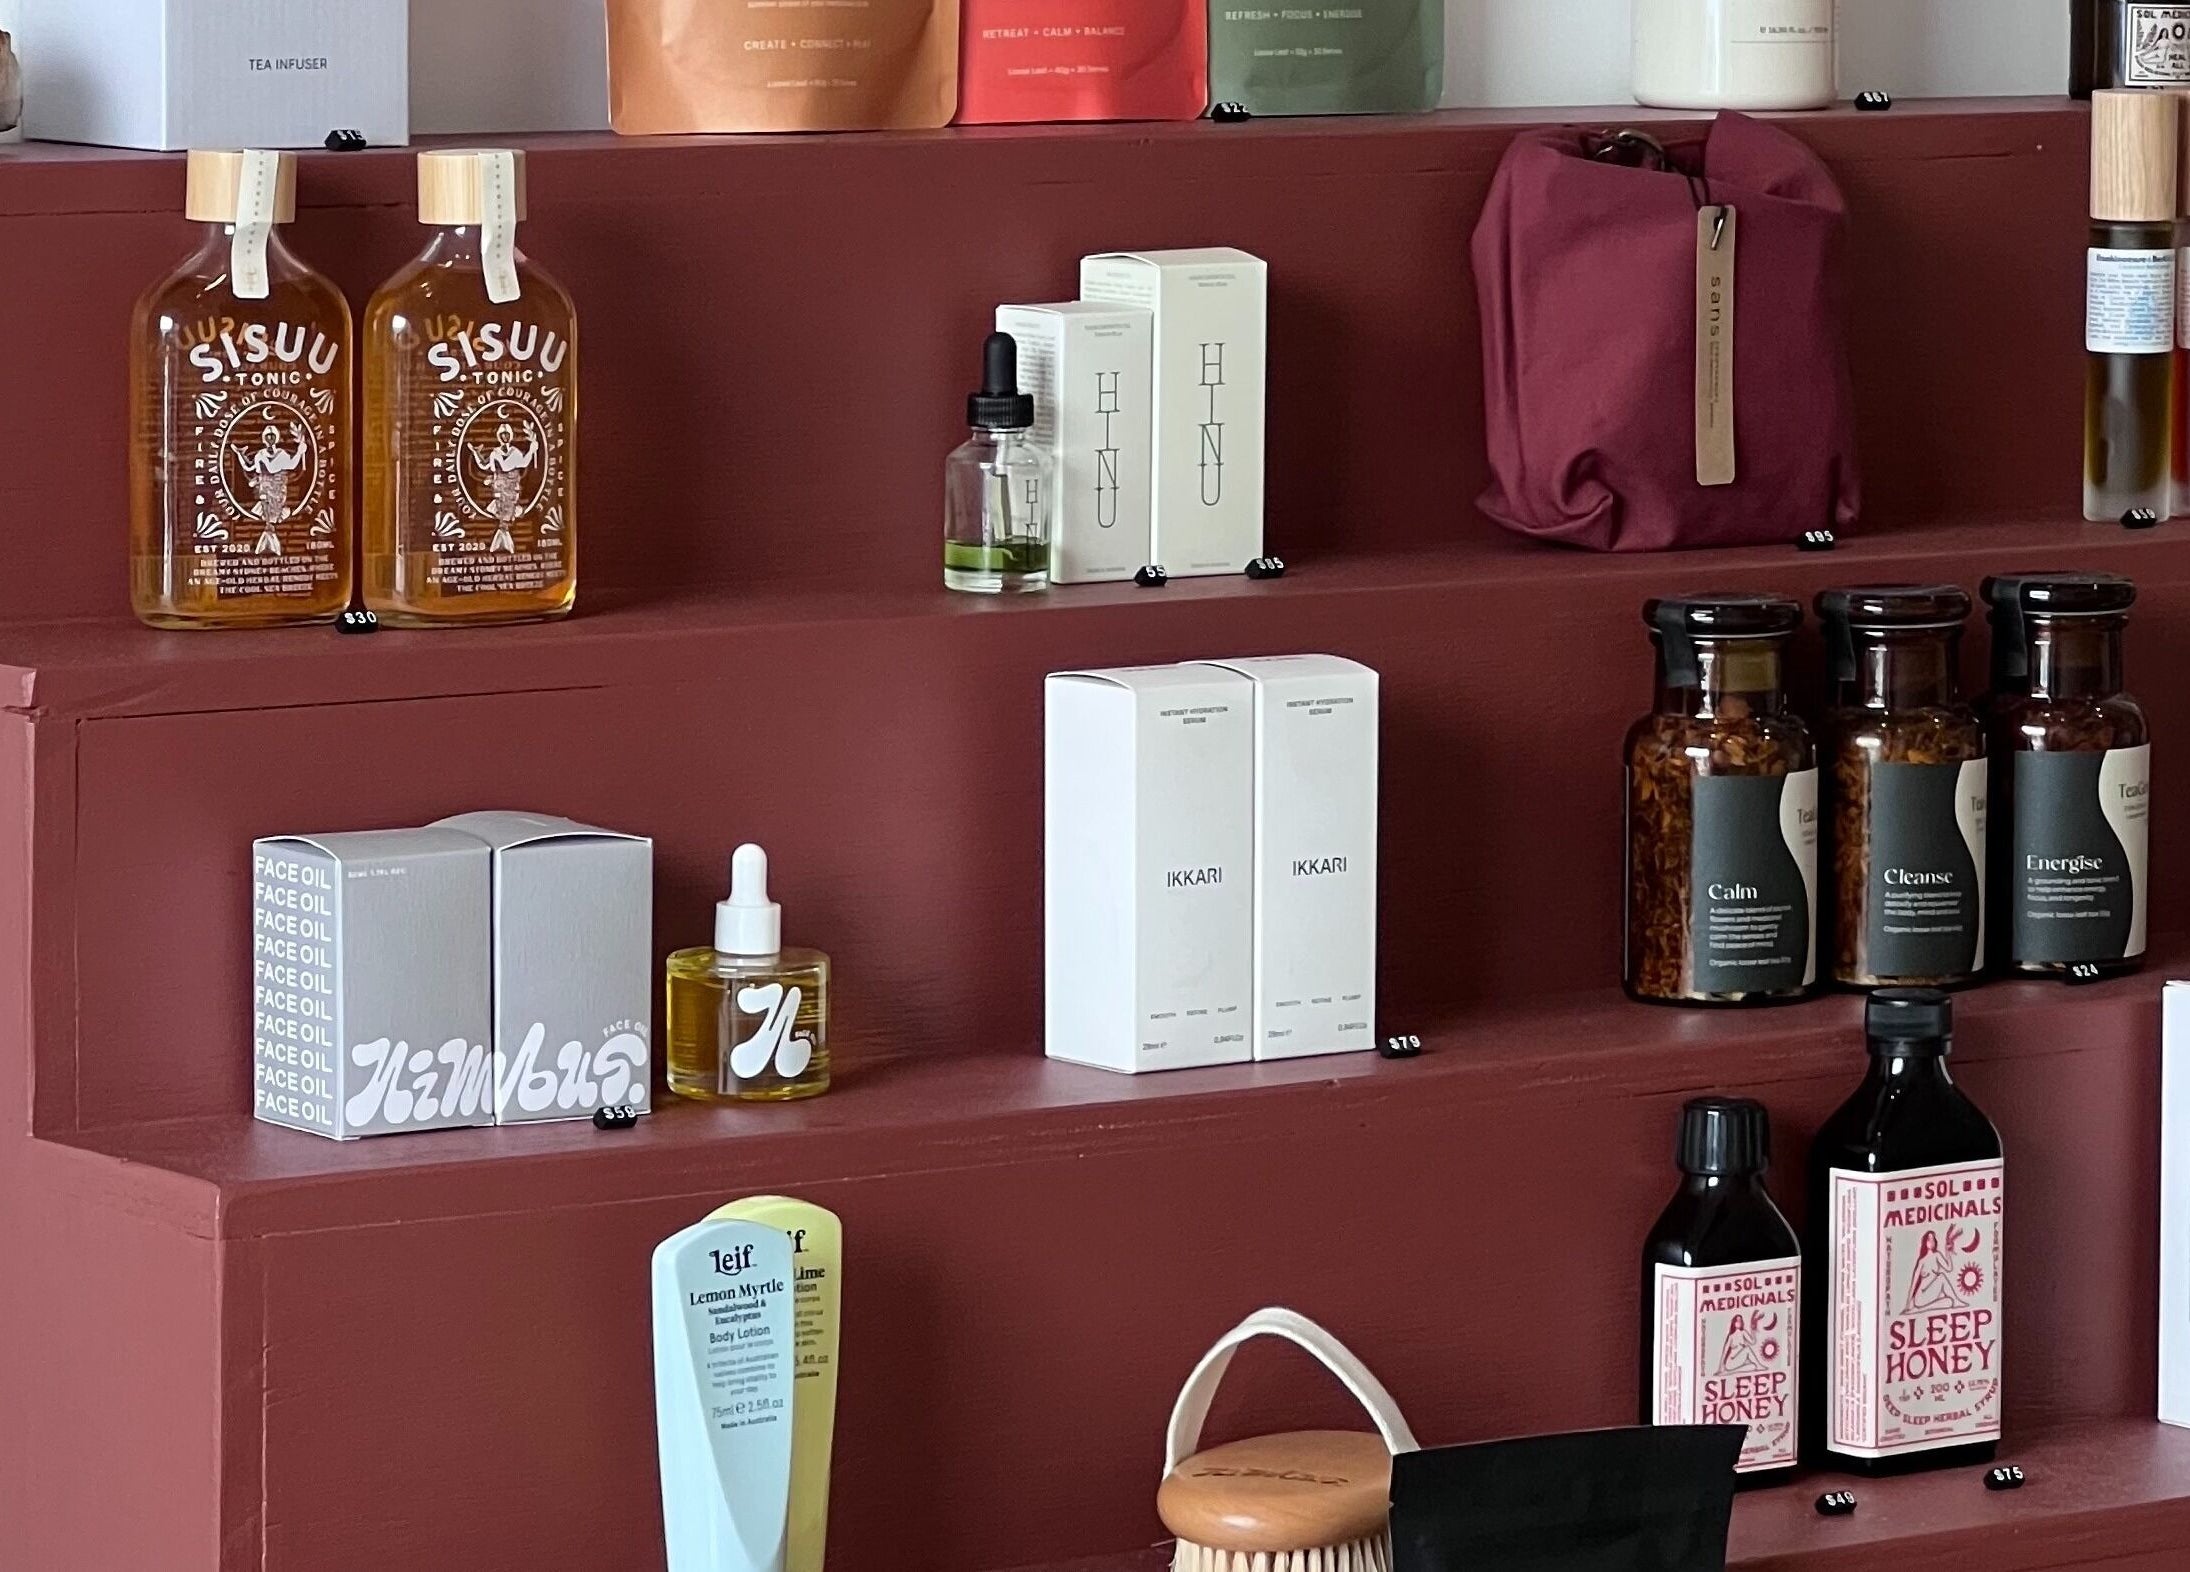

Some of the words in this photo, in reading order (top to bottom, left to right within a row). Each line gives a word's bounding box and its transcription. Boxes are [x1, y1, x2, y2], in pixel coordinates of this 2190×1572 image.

[1225, 10, 1270, 20] REFRESH
[2136, 10, 2156, 18] SOL
[744, 40, 787, 50] CREATE
[983, 28, 1029, 39] RETREAT
[1043, 27, 1072, 37] CALM
[1084, 27, 1125, 36] BALANCE
[249, 59, 272, 71] TEA
[276, 58, 328, 70] INFUSER
[1864, 92, 1888, 102] $67
[1710, 276, 1721, 337] sans
[189, 322, 338, 382] SISUU
[428, 320, 567, 382] SISUU
[235, 371, 300, 386] TONIC
[472, 370, 533, 385] TONIC
[214, 406, 238, 438] DOSE
[263, 388, 317, 422] COURAGE
[1198, 342, 1226, 506] HINU
[444, 440, 457, 484] DAILY
[498, 387, 548, 420] COURAGE
[195, 426, 204, 485] FIRE
[433, 426, 442, 484] FIRE
[1094, 372, 1120, 528] HINU
[328, 425, 336, 500] SPICE
[432, 544, 454, 552] EST
[458, 542, 486, 552] 2020
[1805, 530, 1834, 543] $95
[194, 544, 217, 554] EST
[222, 544, 250, 554] 2020
[344, 611, 377, 624] $30
[256, 856, 298, 882] FACE
[300, 867, 332, 890] OIL
[1292, 856, 1347, 876] IKKARI
[1884, 868, 1953, 884] Cleanse
[2026, 854, 2103, 874] Energise
[1167, 867, 1222, 888] IKKARI
[256, 882, 298, 909] FACE
[300, 893, 332, 916] OIL
[1708, 883, 1758, 900] Calm
[256, 908, 298, 935] FACE
[300, 919, 332, 942] OIL
[256, 934, 298, 961] FACE
[300, 945, 332, 968] OIL
[256, 960, 298, 988] FACE
[300, 971, 332, 994] OIL
[2072, 964, 2098, 976] $24
[256, 986, 298, 1014] FACE
[300, 998, 332, 1020] OIL
[256, 1012, 298, 1040] FACE
[300, 1024, 332, 1046] OIL
[603, 1020, 630, 1038] FACE
[634, 1020, 648, 1036] OIL
[256, 1038, 298, 1065] FACE
[300, 1050, 332, 1072] OIL
[1388, 1036, 1421, 1050] $79
[256, 1064, 299, 1091] FACE
[300, 1076, 332, 1099] OIL
[256, 1089, 299, 1118] FACE
[300, 1102, 332, 1125] OIL
[1925, 1180, 1960, 1200] SOL
[1884, 1196, 2001, 1228] MEDICINALS
[690, 1288, 736, 1306] Lemon
[738, 1278, 784, 1300] Myrtle
[1734, 1276, 1762, 1292] SOL
[708, 1300, 759, 1316] Sandalwood
[1700, 1289, 1796, 1313] MEDICINALS
[715, 1311, 762, 1326] Eucalyptus
[1890, 1309, 1993, 1350] SLEEP
[710, 1330, 735, 1344] Body
[738, 1326, 770, 1340] Lotion
[1885, 1340, 1996, 1384] HONEY
[1704, 1372, 1787, 1402] SLEEP
[1702, 1394, 1790, 1424] HONEY
[1902, 1414, 1930, 1426] SLEEP
[1932, 1409, 1972, 1424] HERBAL
[1974, 1378, 1998, 1412] SYRUP
[748, 1415, 778, 1425] Australia
[1994, 1466, 2024, 1481] $75
